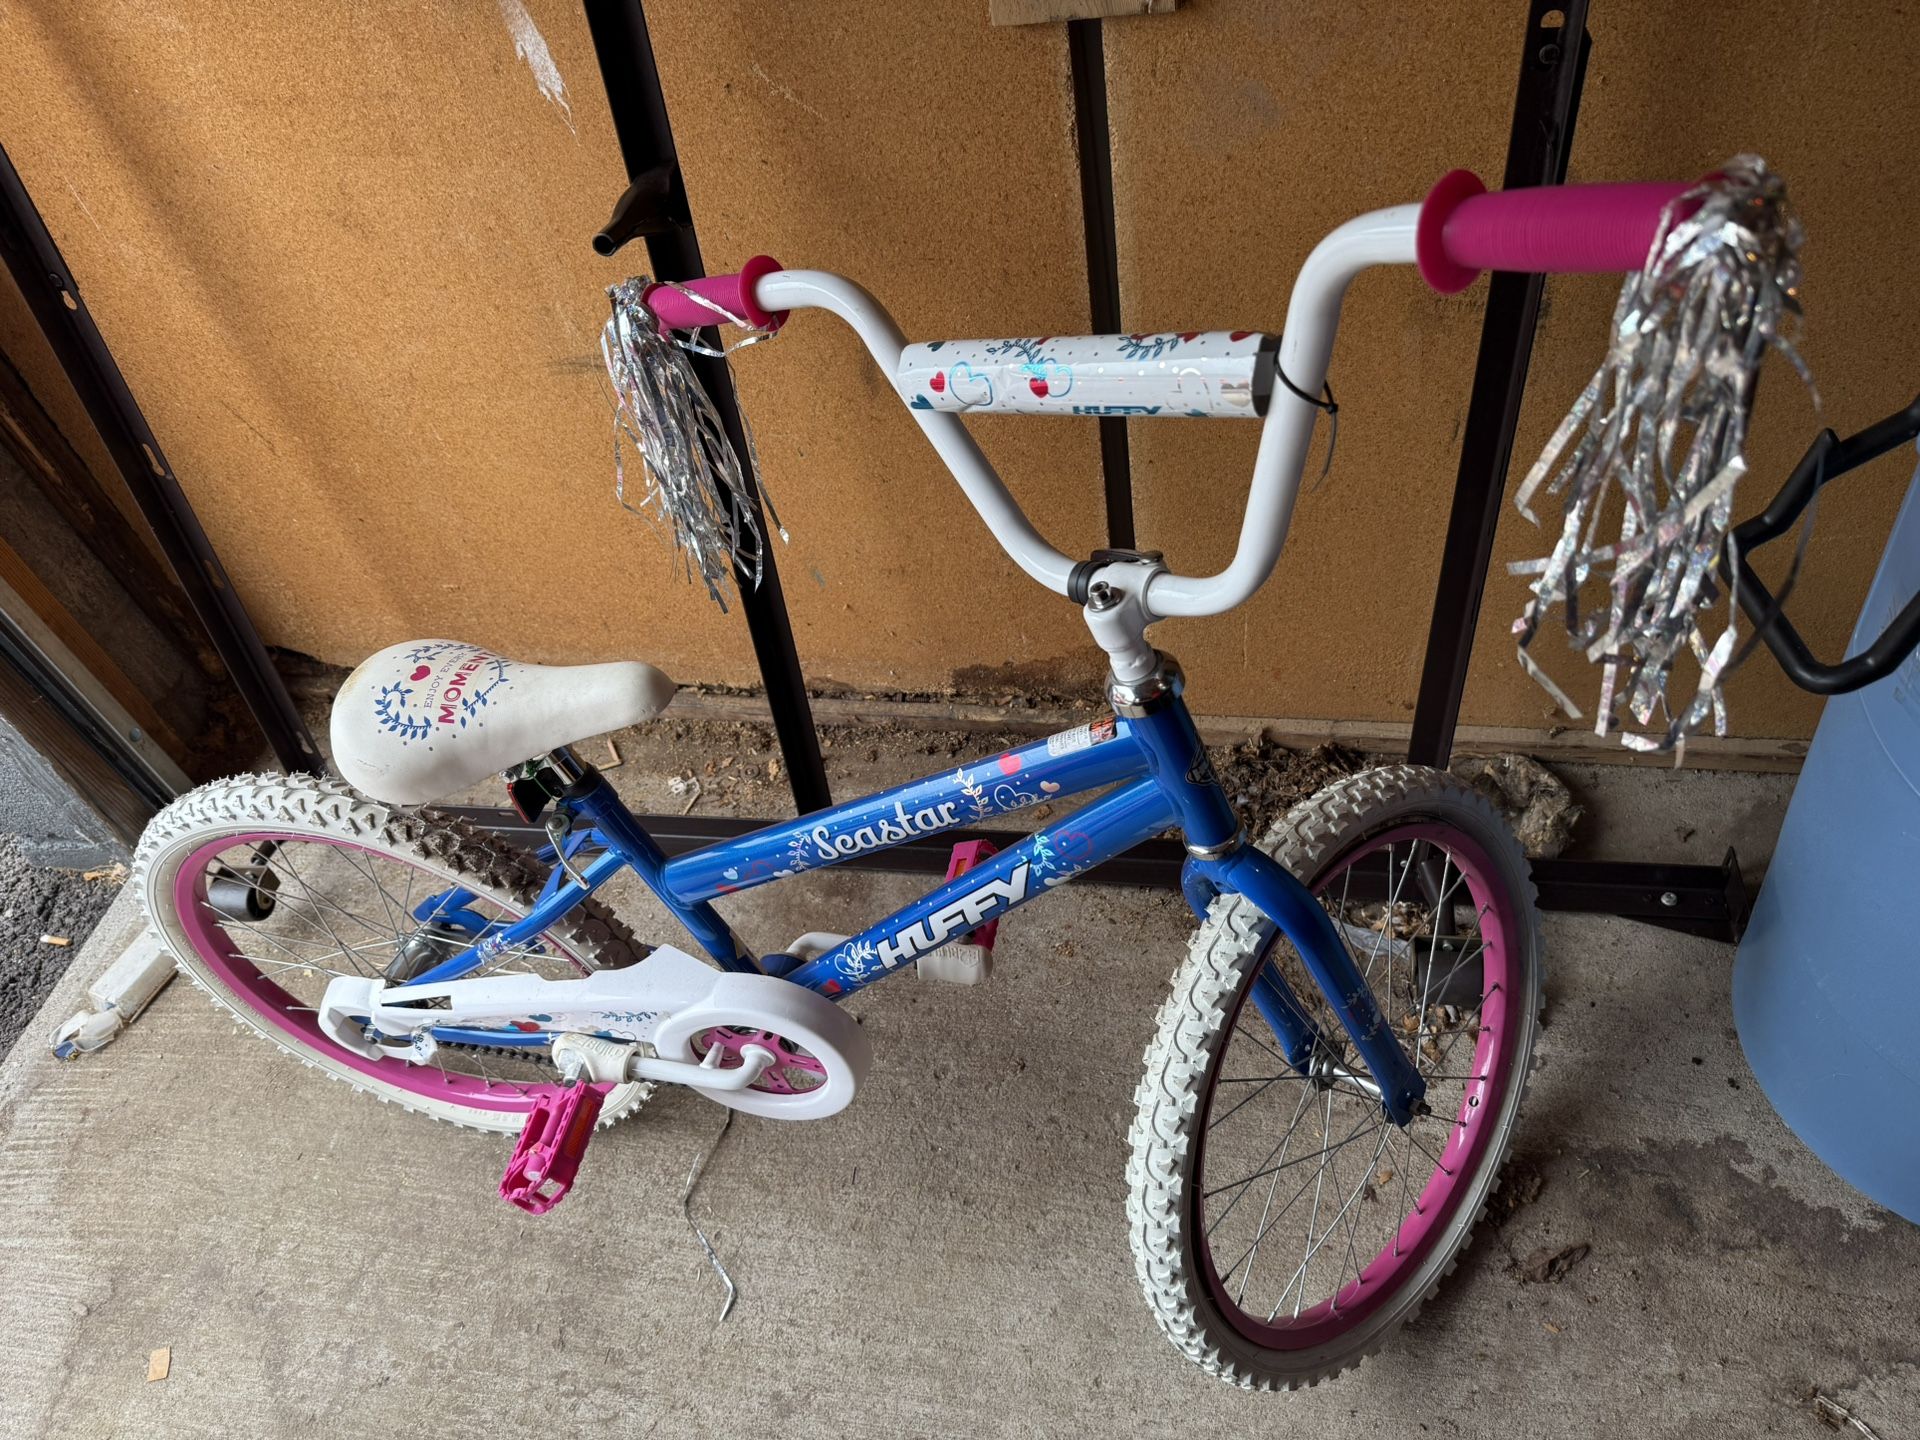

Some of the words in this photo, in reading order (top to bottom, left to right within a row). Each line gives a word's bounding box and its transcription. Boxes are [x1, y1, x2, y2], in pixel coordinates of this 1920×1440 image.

[1073, 405, 1162, 415] HUFFY
[424, 675, 443, 708] ENJOY
[438, 652, 496, 724] MOMENT
[812, 801, 960, 861] Seastar
[876, 860, 1031, 969] HUFFY
